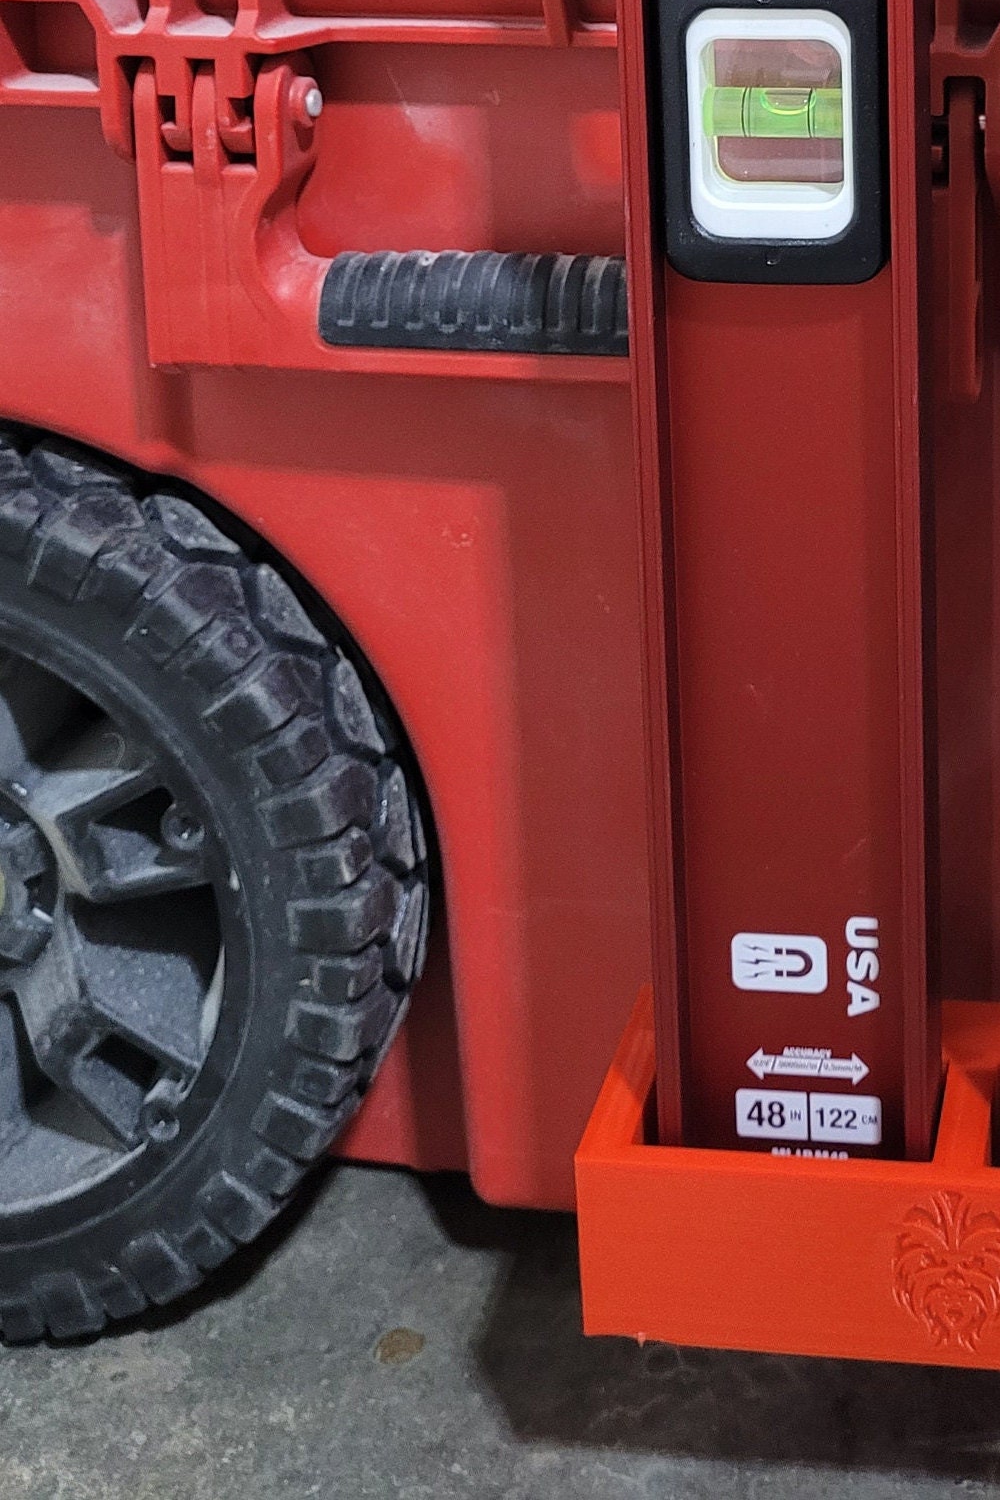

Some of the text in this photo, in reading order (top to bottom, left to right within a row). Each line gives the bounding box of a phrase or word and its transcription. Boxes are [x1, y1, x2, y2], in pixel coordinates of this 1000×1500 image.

[845, 916, 881, 1017] USA
[747, 1100, 801, 1129] 48 IN
[815, 1107, 857, 1129] 122
